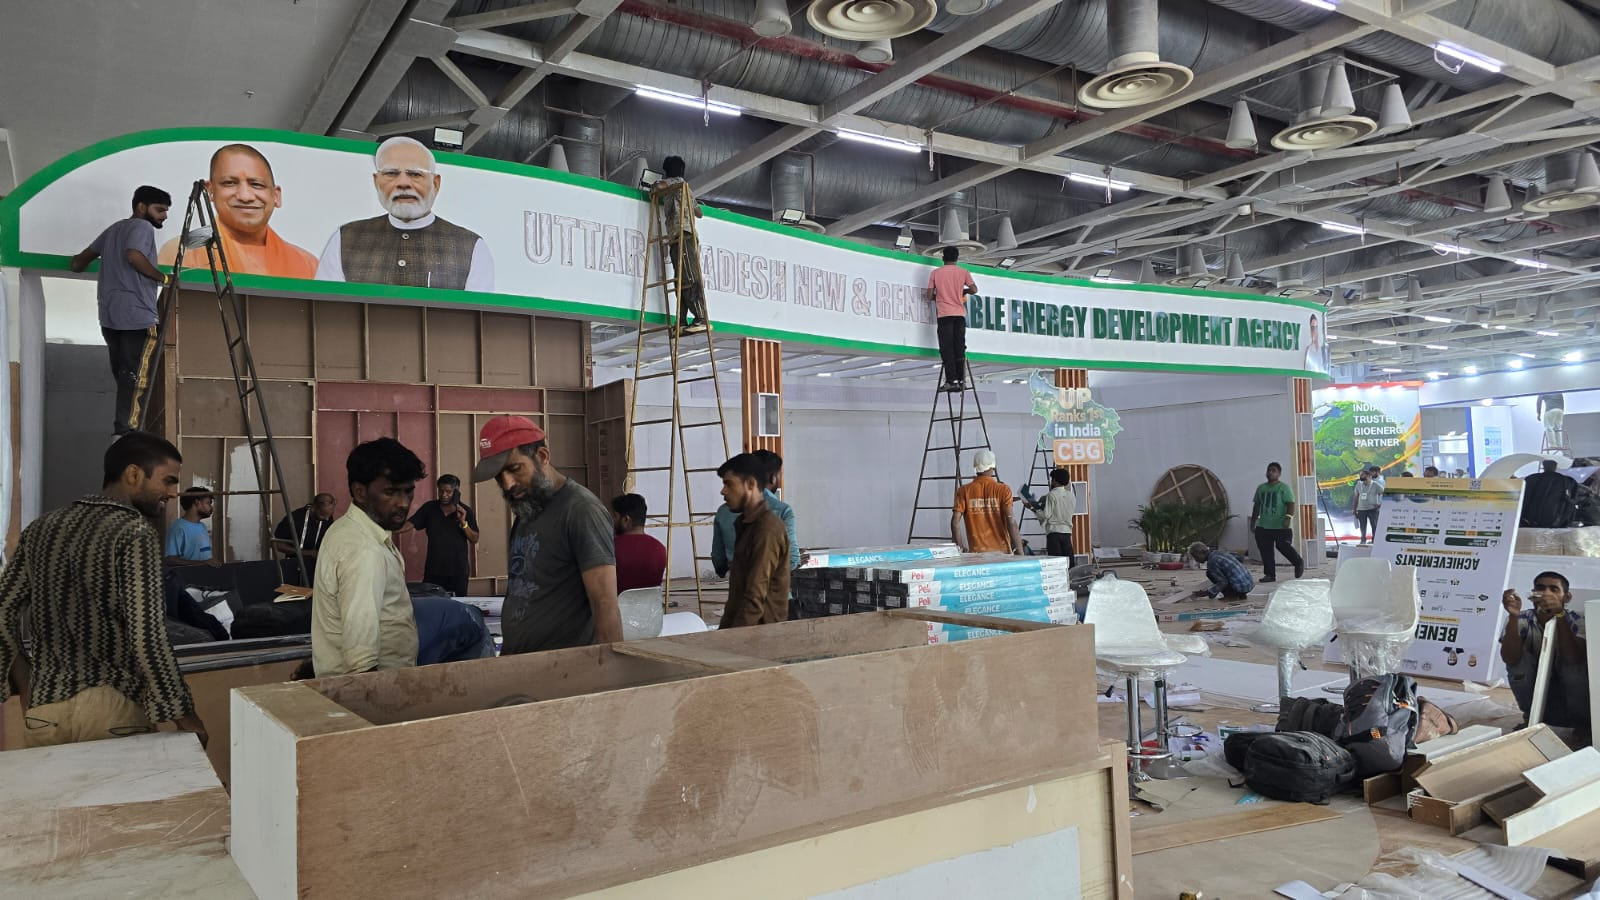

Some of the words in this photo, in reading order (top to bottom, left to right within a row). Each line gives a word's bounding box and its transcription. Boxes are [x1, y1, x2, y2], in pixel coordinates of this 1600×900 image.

[523, 210, 647, 278] UTTAR
[793, 263, 847, 312] NEW
[851, 277, 872, 316] &
[1010, 299, 1088, 338] ENERGY
[1091, 307, 1232, 346] DEVELOPMENT
[1236, 317, 1301, 350] AGENCY
[1059, 387, 1092, 409] UP
[1054, 423, 1067, 436] in
[1069, 423, 1101, 437] India
[1354, 438, 1400, 447] PARTNER
[1057, 442, 1101, 460] CBG
[1395, 553, 1481, 571] ACHIEVEMENTS
[953, 567, 992, 578] ELEGANCE
[959, 592, 995, 603] ELEGANCE
[965, 604, 1001, 615] ELEGANCE
